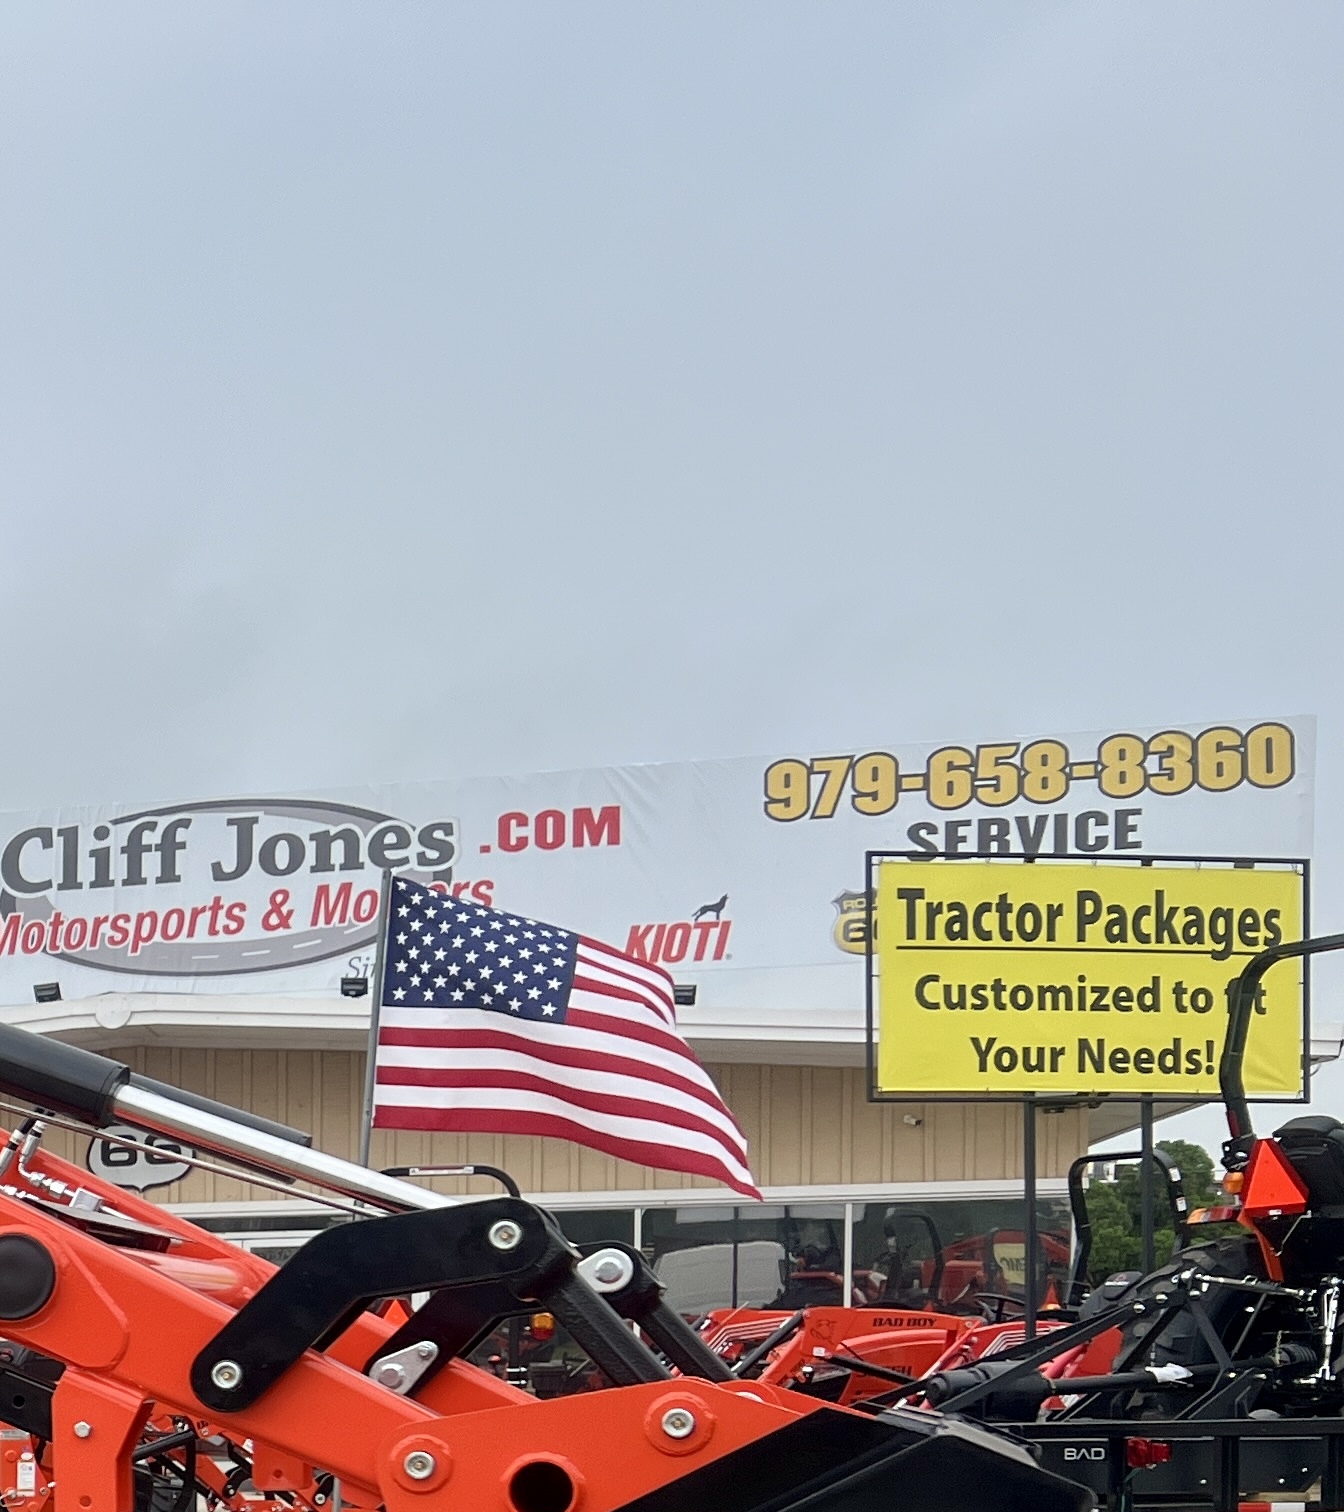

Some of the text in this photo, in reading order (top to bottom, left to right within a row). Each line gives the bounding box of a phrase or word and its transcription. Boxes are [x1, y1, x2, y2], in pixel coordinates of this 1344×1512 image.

[763, 721, 1296, 822] 979-658-8360
[1, 817, 190, 894] Cliff
[211, 817, 456, 881] Jones
[479, 806, 621, 854] .COM
[906, 808, 1143, 862] SERVICE
[261, 890, 294, 930] &
[309, 879, 495, 927] Mors
[897, 888, 1282, 960] Tractor Packages
[625, 920, 732, 964] KIOTI
[914, 974, 1267, 1015] Customized to ft
[970, 1038, 1216, 1076] Your Needs!
[100, 1134, 182, 1167] 66
[872, 1317, 937, 1328] BAD BOY
[1063, 1445, 1106, 1461] BAD
